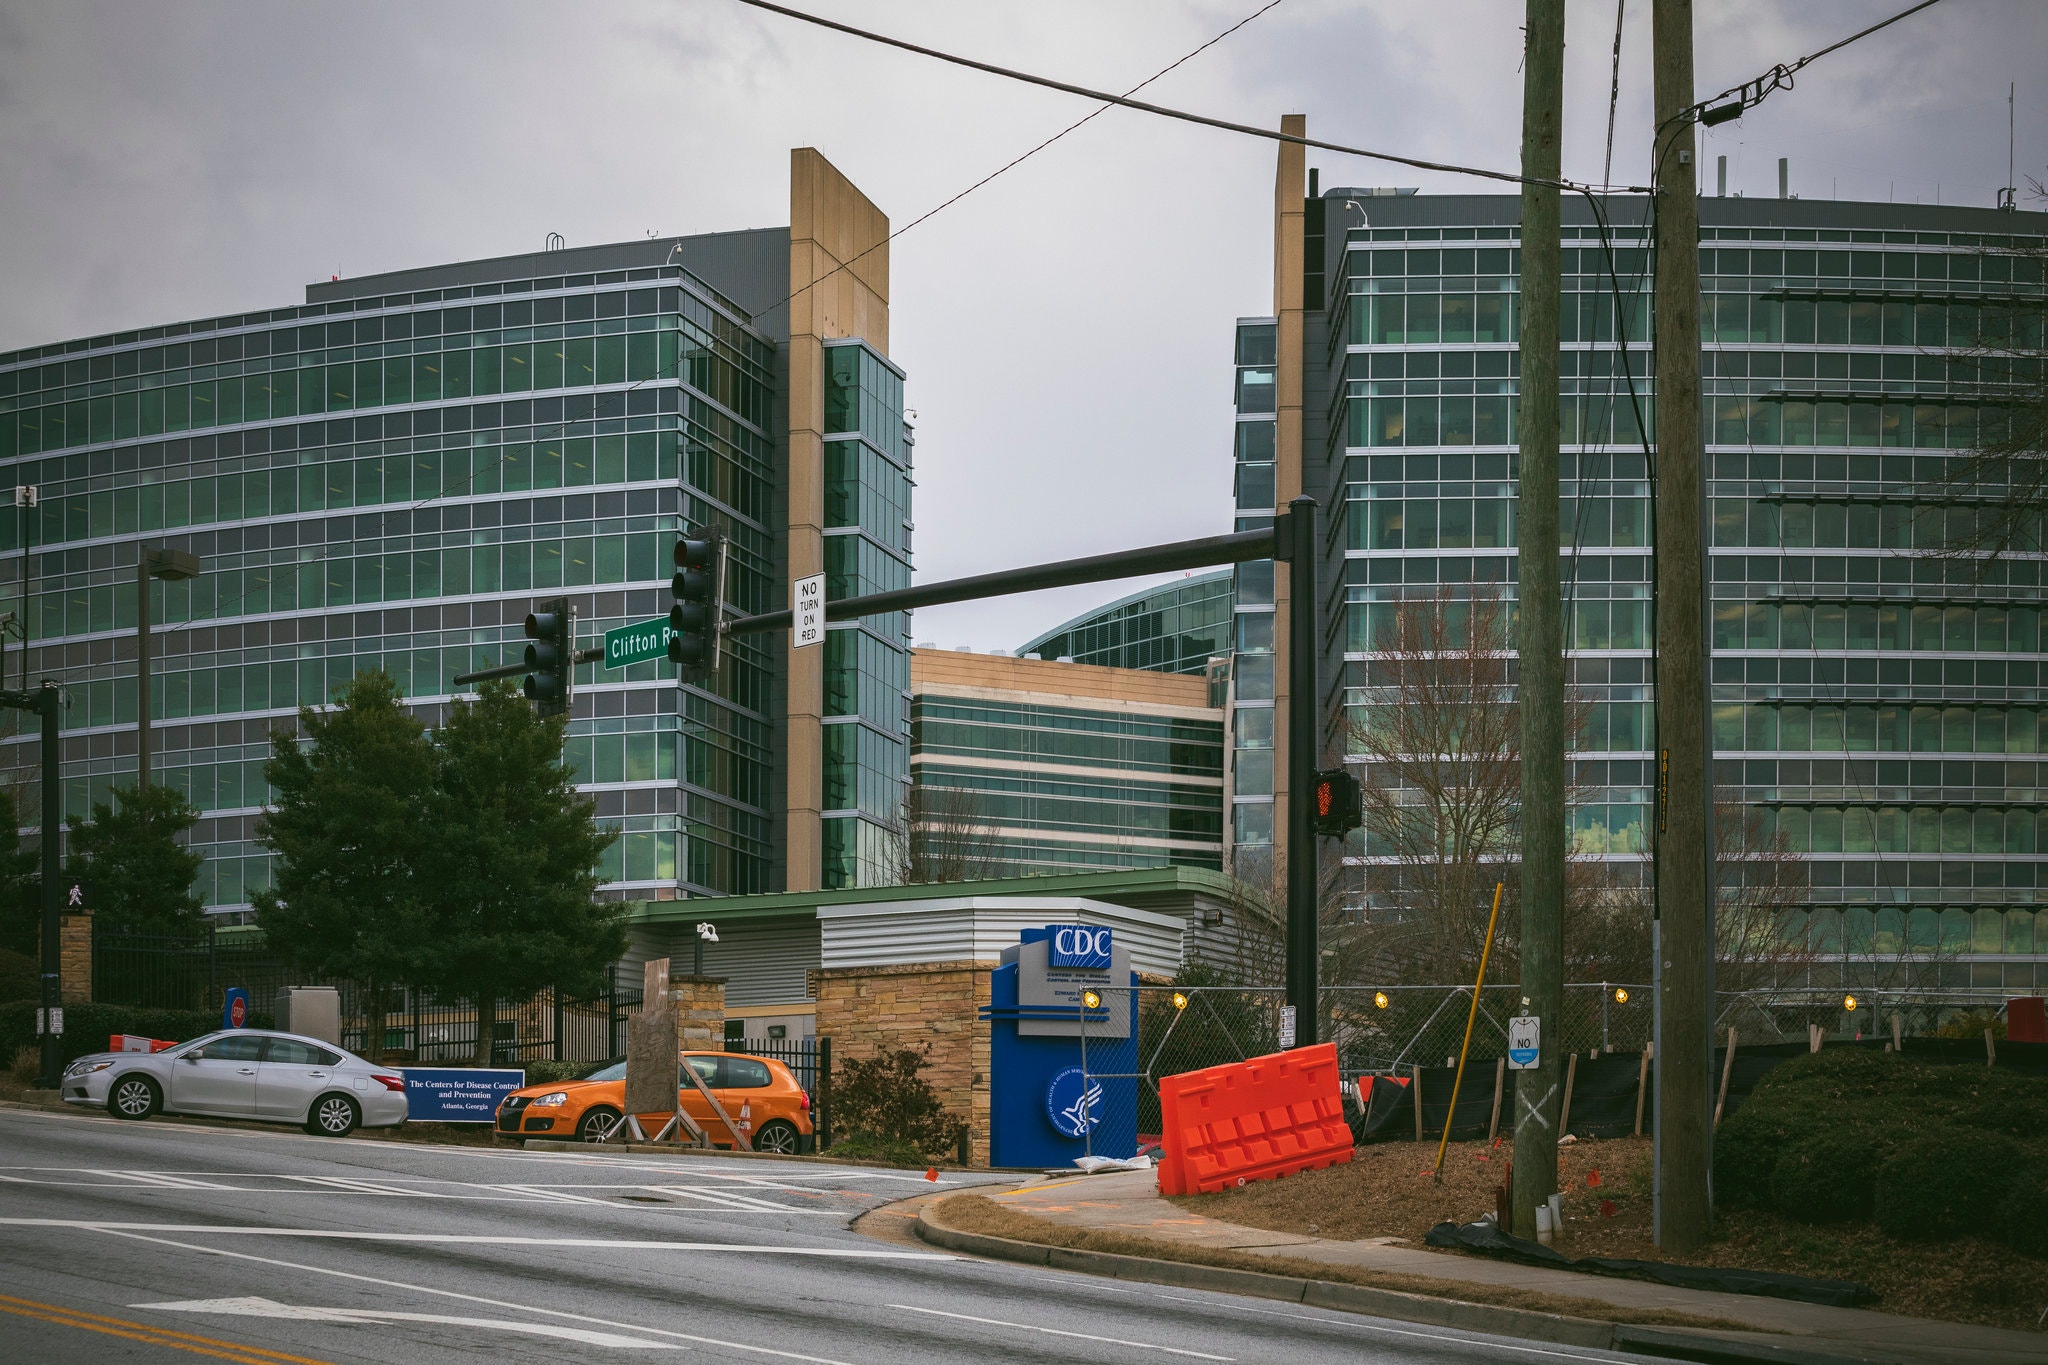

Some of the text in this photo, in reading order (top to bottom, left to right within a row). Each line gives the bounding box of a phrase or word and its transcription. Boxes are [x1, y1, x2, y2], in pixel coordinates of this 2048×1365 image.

[802, 582, 817, 597] NO
[800, 599, 818, 612] TURN
[804, 614, 815, 626] ON
[801, 628, 816, 641] RED
[611, 634, 657, 659] Clifton
[1055, 929, 1110, 957] CDC
[233, 1006, 244, 1018] STOP
[1517, 1038, 1531, 1048] NO
[409, 1080, 423, 1088] The
[425, 1080, 453, 1088] Centers
[466, 1081, 492, 1089] Disease
[493, 1082, 520, 1090] Control
[438, 1090, 491, 1099] and Prevention
[465, 1103, 488, 1111] Georgia
